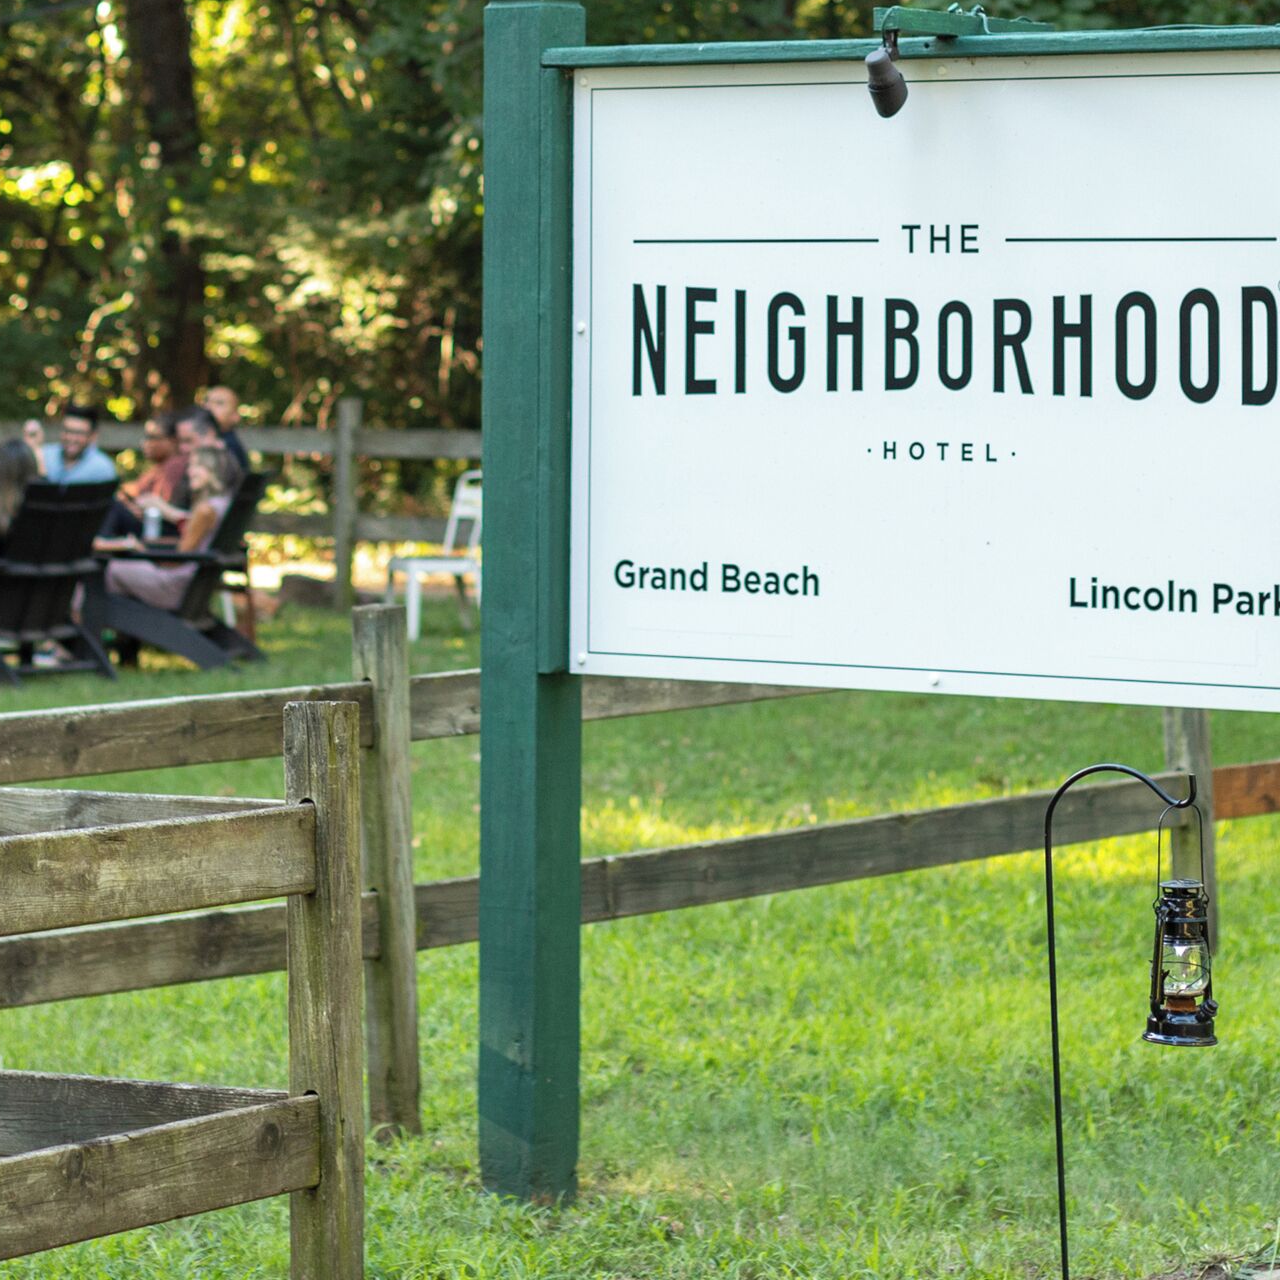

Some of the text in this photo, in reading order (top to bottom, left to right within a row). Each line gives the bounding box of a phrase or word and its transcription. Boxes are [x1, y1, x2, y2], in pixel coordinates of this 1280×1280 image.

[901, 224, 980, 254] THE
[614, 559, 819, 597] Grand Beach
[1069, 576, 1198, 613] Lincoln
